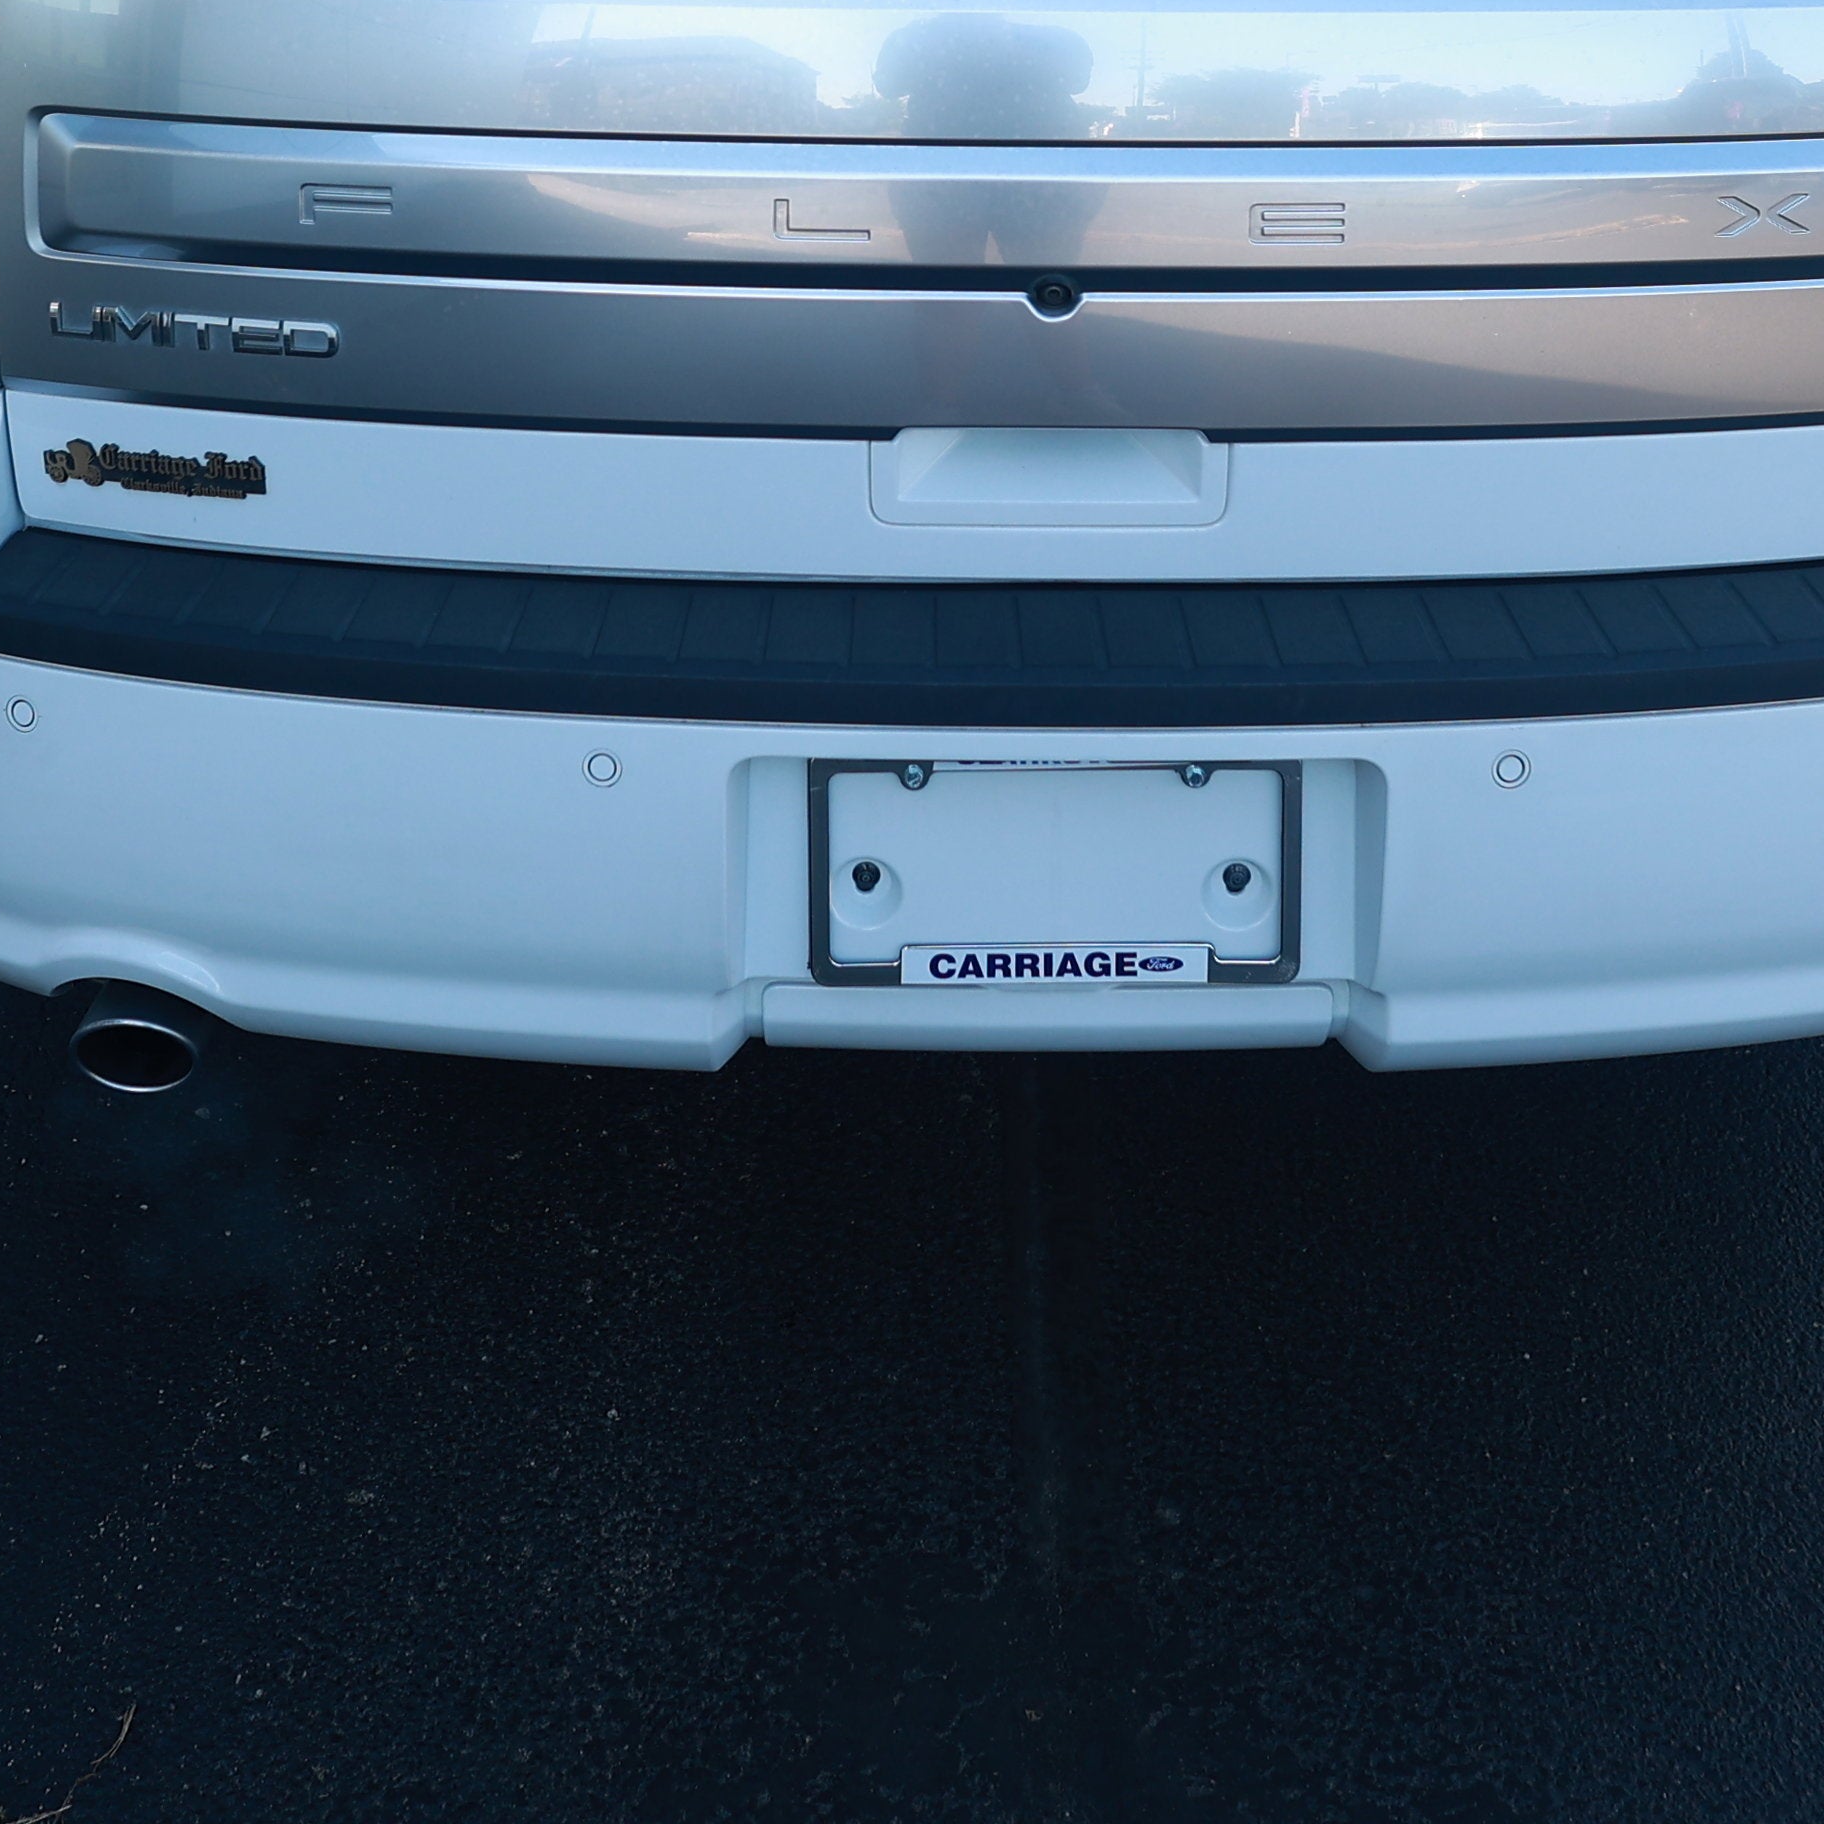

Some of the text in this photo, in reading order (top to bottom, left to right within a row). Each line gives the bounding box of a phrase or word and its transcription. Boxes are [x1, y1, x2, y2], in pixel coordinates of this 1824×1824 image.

[298, 181, 1812, 245] FLEX
[48, 301, 340, 359] LIMITED
[98, 443, 266, 482] Carriage Ford
[928, 951, 1138, 980] CARRIAGE
